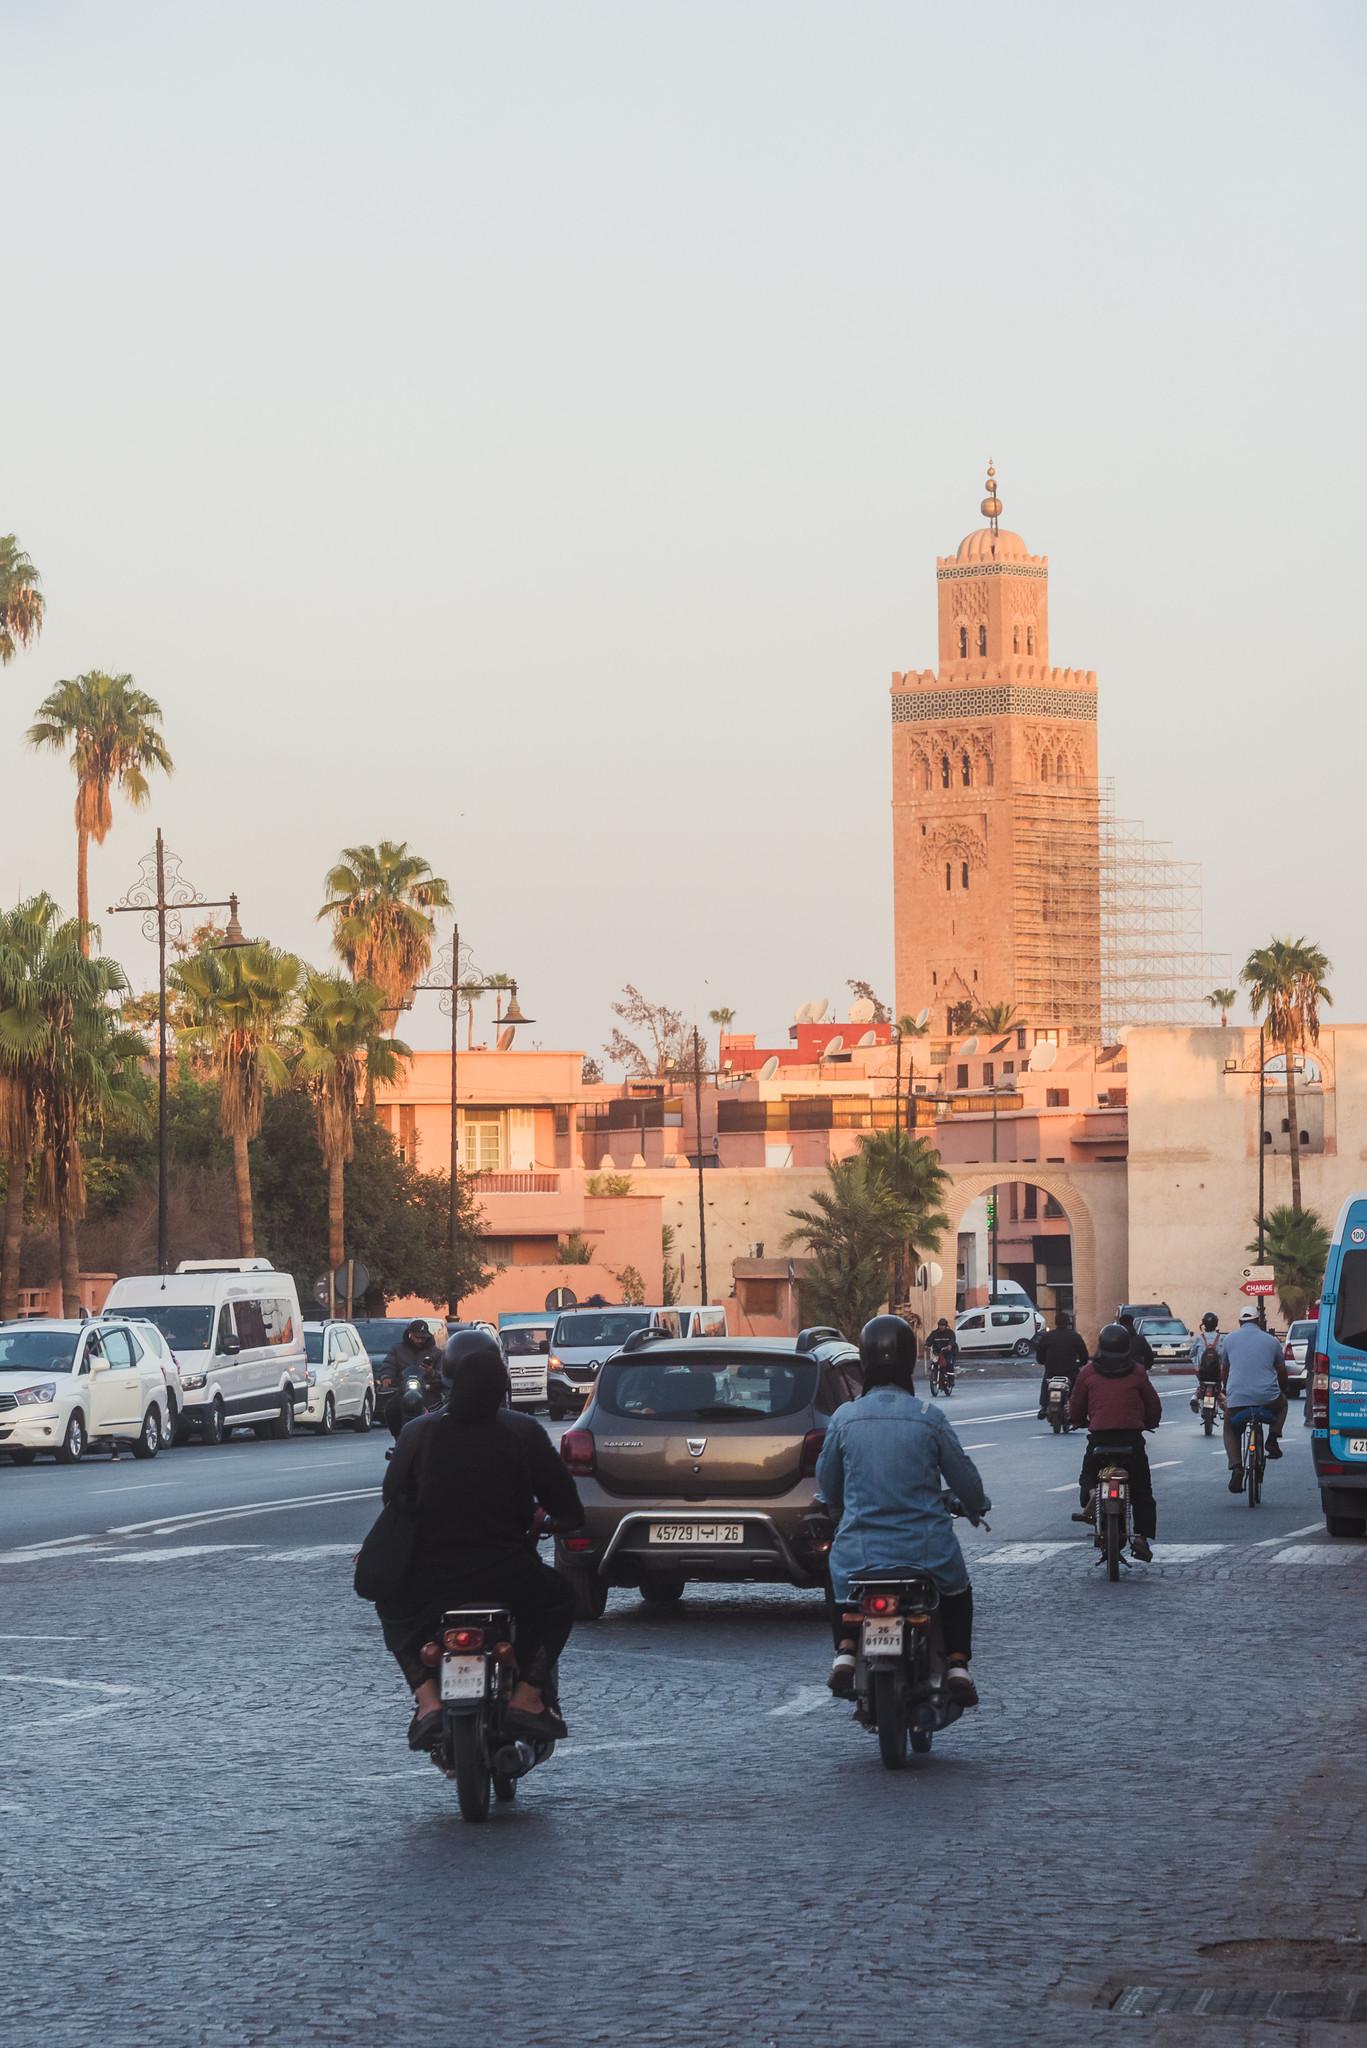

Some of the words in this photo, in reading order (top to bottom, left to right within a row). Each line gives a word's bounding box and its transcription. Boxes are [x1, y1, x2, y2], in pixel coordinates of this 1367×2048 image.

[1246, 1284, 1273, 1292] CHANGE
[656, 1526, 693, 1541] 45729
[724, 1526, 739, 1541] 26
[878, 1626, 889, 1634] 26
